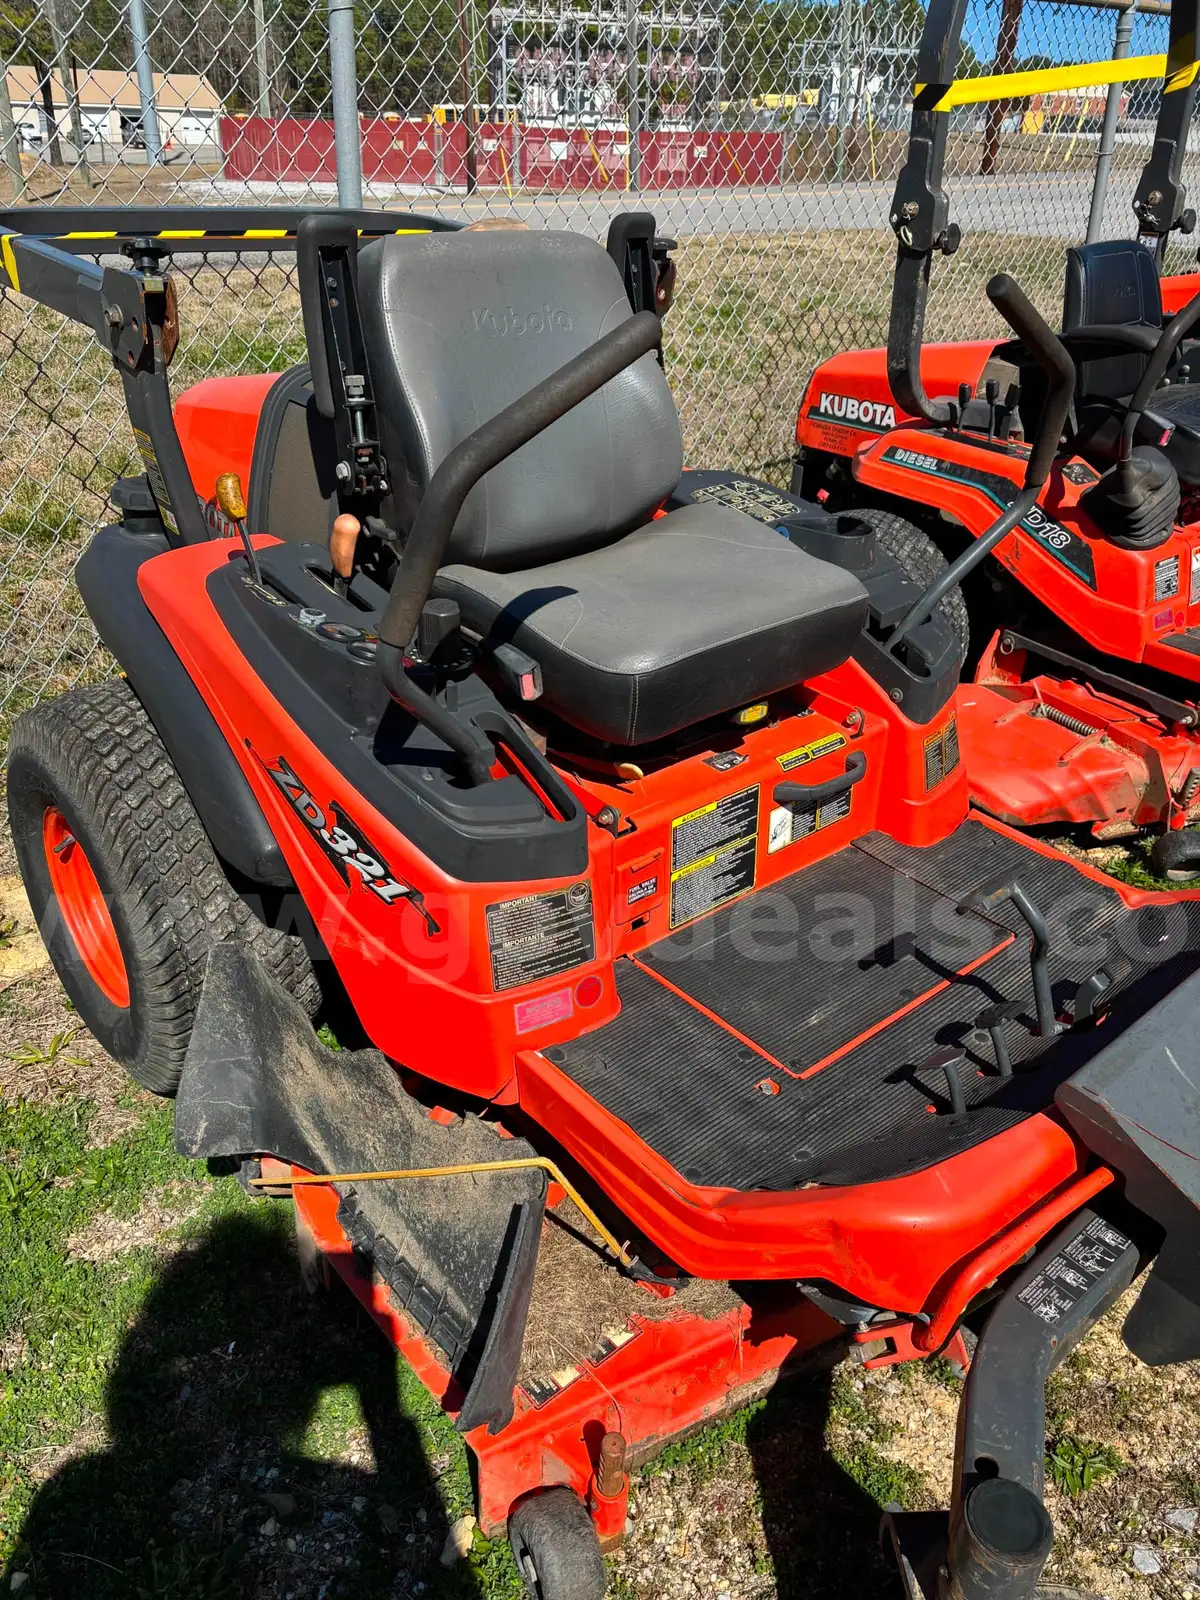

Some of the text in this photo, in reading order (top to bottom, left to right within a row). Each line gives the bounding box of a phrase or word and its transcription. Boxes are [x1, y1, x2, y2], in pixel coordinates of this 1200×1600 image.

[820, 392, 897, 428] KUBOTA
[894, 448, 938, 470] DIESEL
[1007, 500, 1071, 549] D18
[686, 808, 707, 821] CAUTION
[267, 762, 411, 905] ZD321
[499, 895, 539, 909] IMPORTANT
[502, 932, 545, 949] IMPORTANTE
